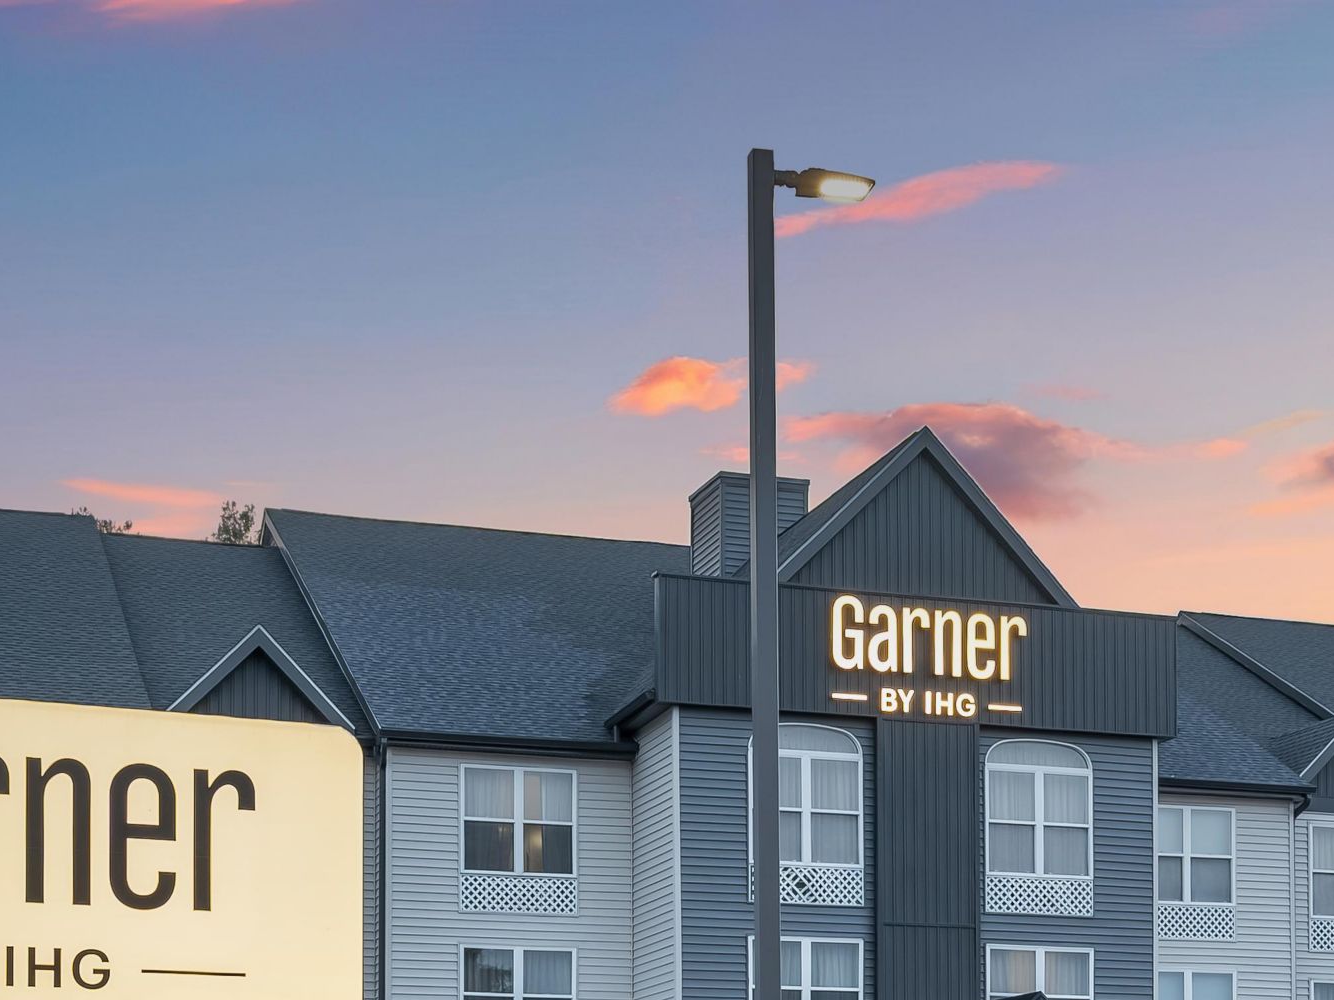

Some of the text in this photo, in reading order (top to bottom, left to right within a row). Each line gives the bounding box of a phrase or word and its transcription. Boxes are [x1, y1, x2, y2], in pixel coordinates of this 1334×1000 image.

[832, 594, 1028, 681] Garner
[880, 687, 977, 718] BY IHG
[5, 945, 111, 990] IHG
